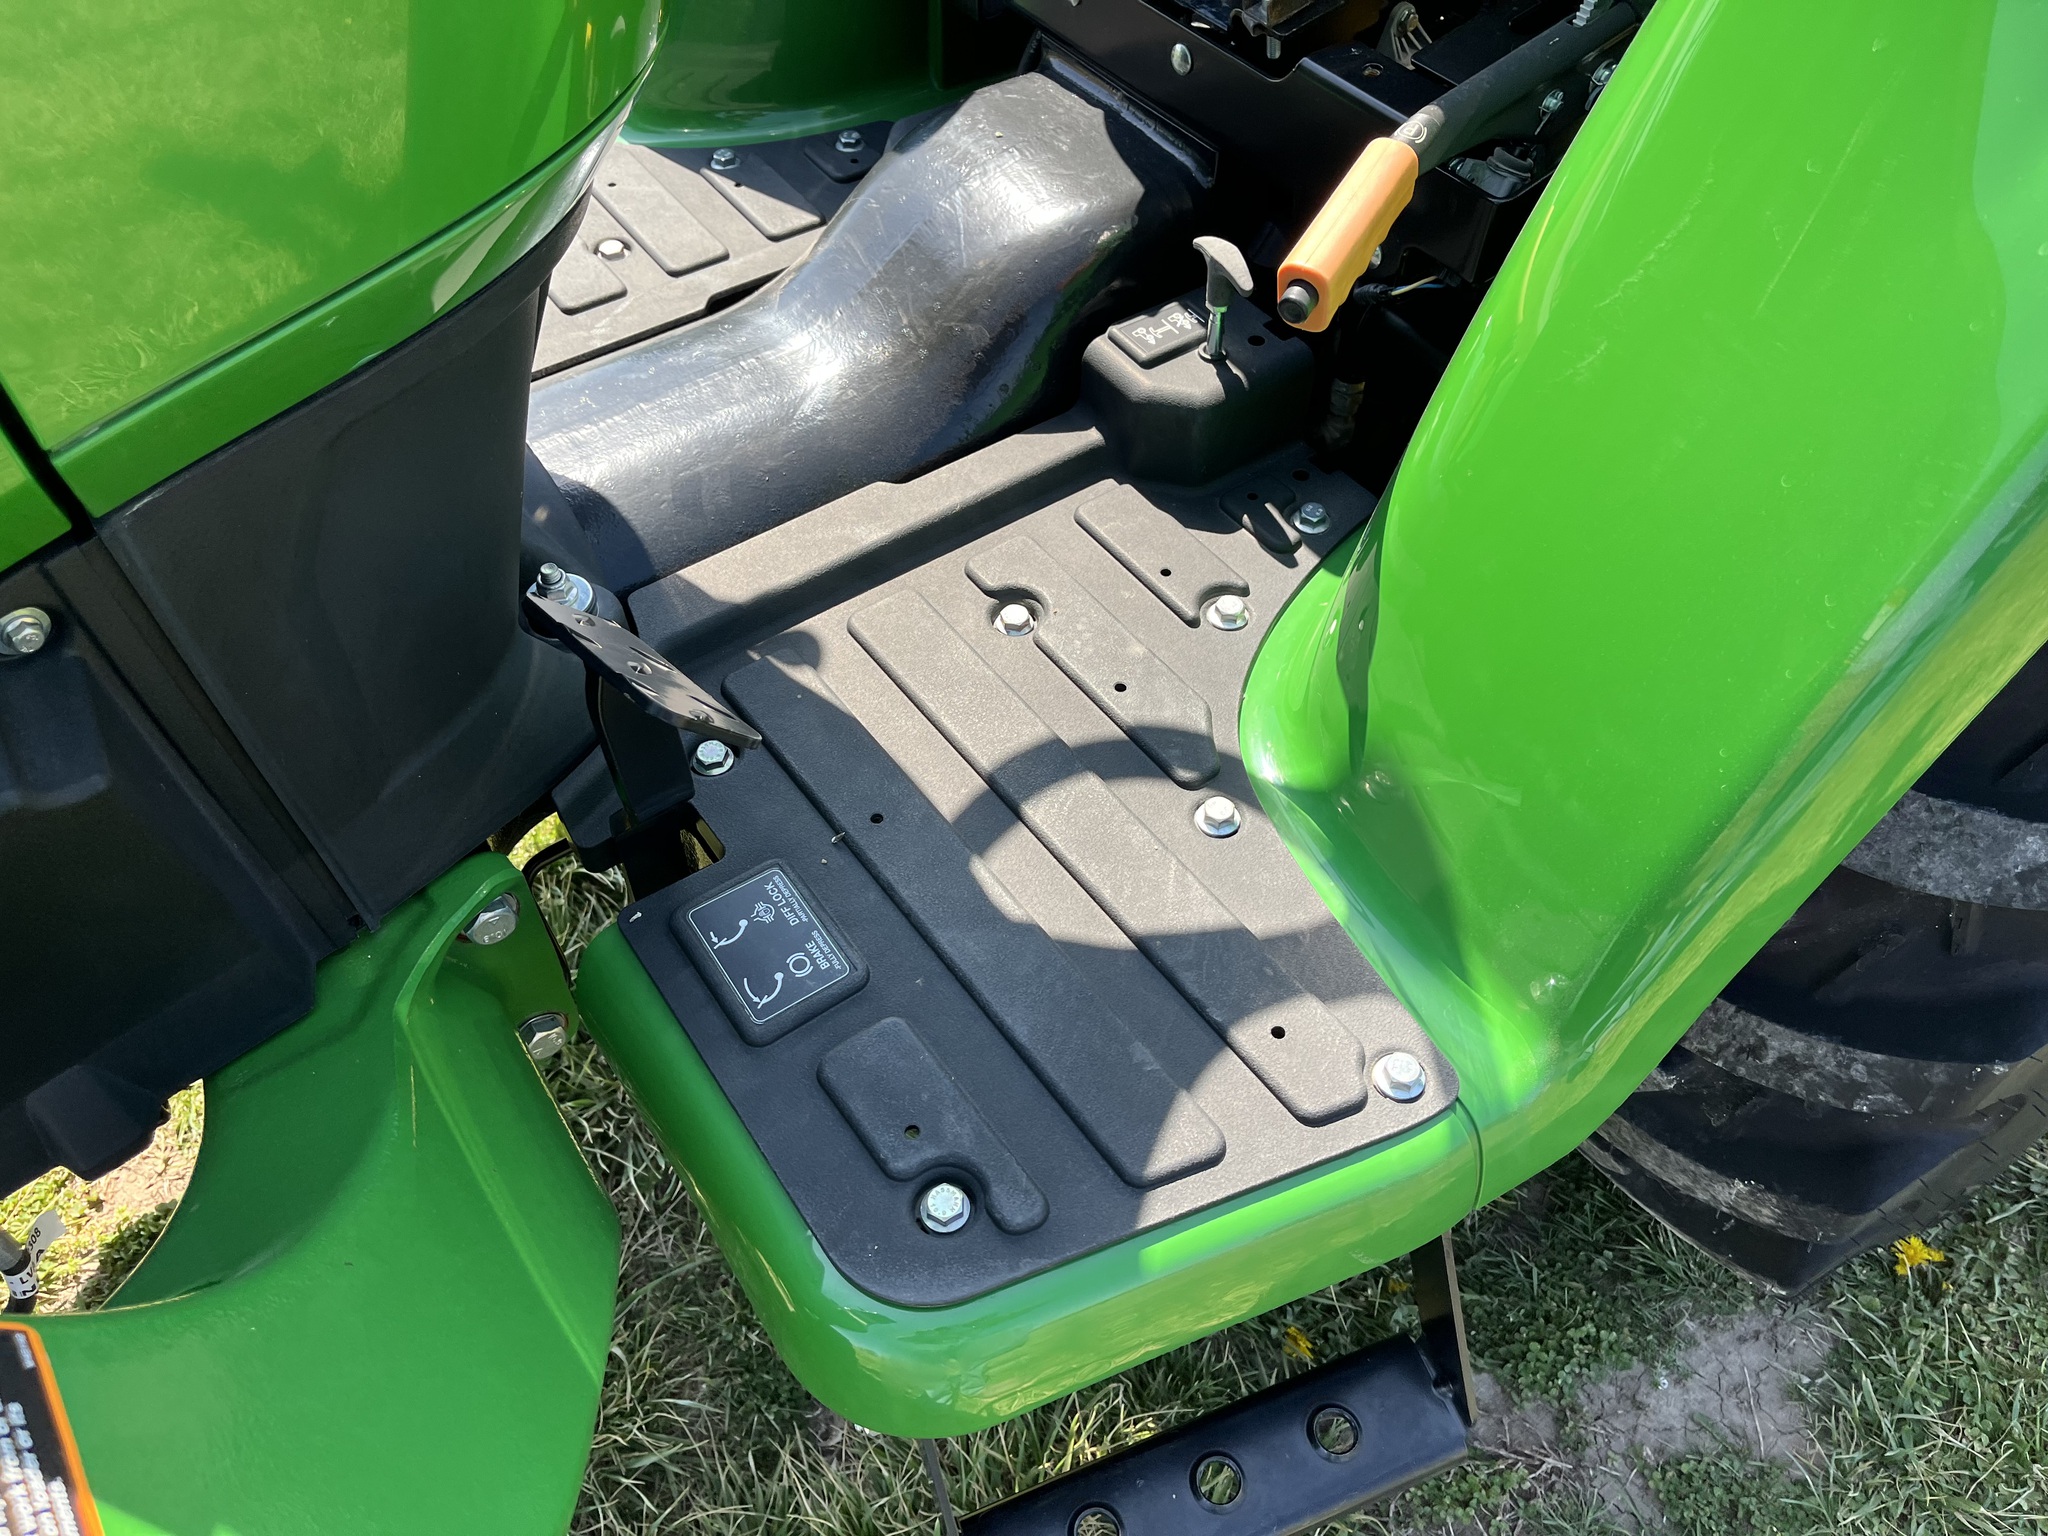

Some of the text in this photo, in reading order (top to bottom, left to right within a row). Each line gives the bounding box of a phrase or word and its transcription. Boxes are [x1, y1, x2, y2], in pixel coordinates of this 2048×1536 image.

[773, 875, 792, 898] DEPRESS
[764, 881, 800, 927] DIFF LOCK
[805, 940, 831, 970] BRAKE
[811, 930, 832, 954] DEPRESS
